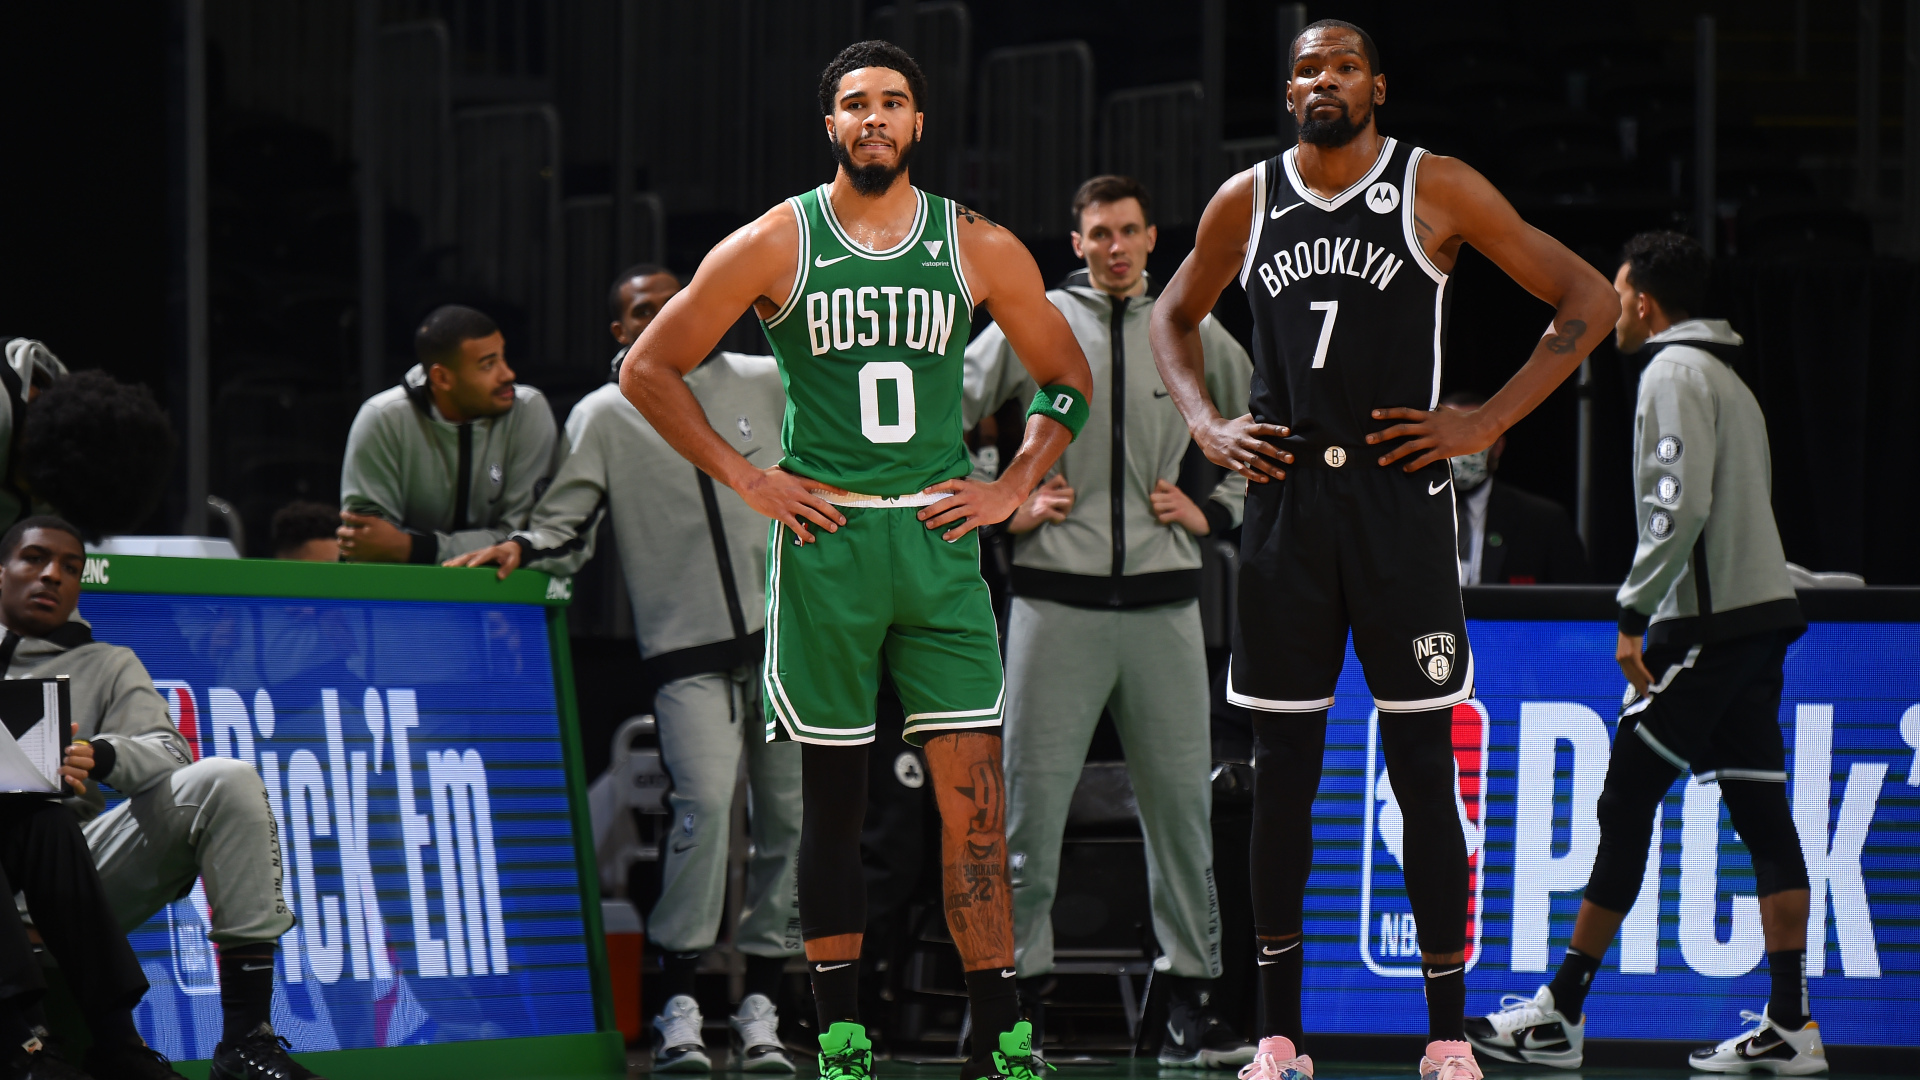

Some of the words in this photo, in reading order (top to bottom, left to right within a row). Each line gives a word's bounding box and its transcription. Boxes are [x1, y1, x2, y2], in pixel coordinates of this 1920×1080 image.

[1258, 237, 1404, 298] BROOKLYN
[806, 286, 956, 356] BOSTON
[1310, 300, 1339, 369] 7
[858, 361, 917, 444] 0
[1052, 393, 1074, 415] 0
[81, 557, 110, 585] ANC
[546, 576, 572, 600] ANC
[1417, 634, 1455, 660] NETS
[1436, 658, 1444, 677] B
[1380, 911, 1423, 957] NB
